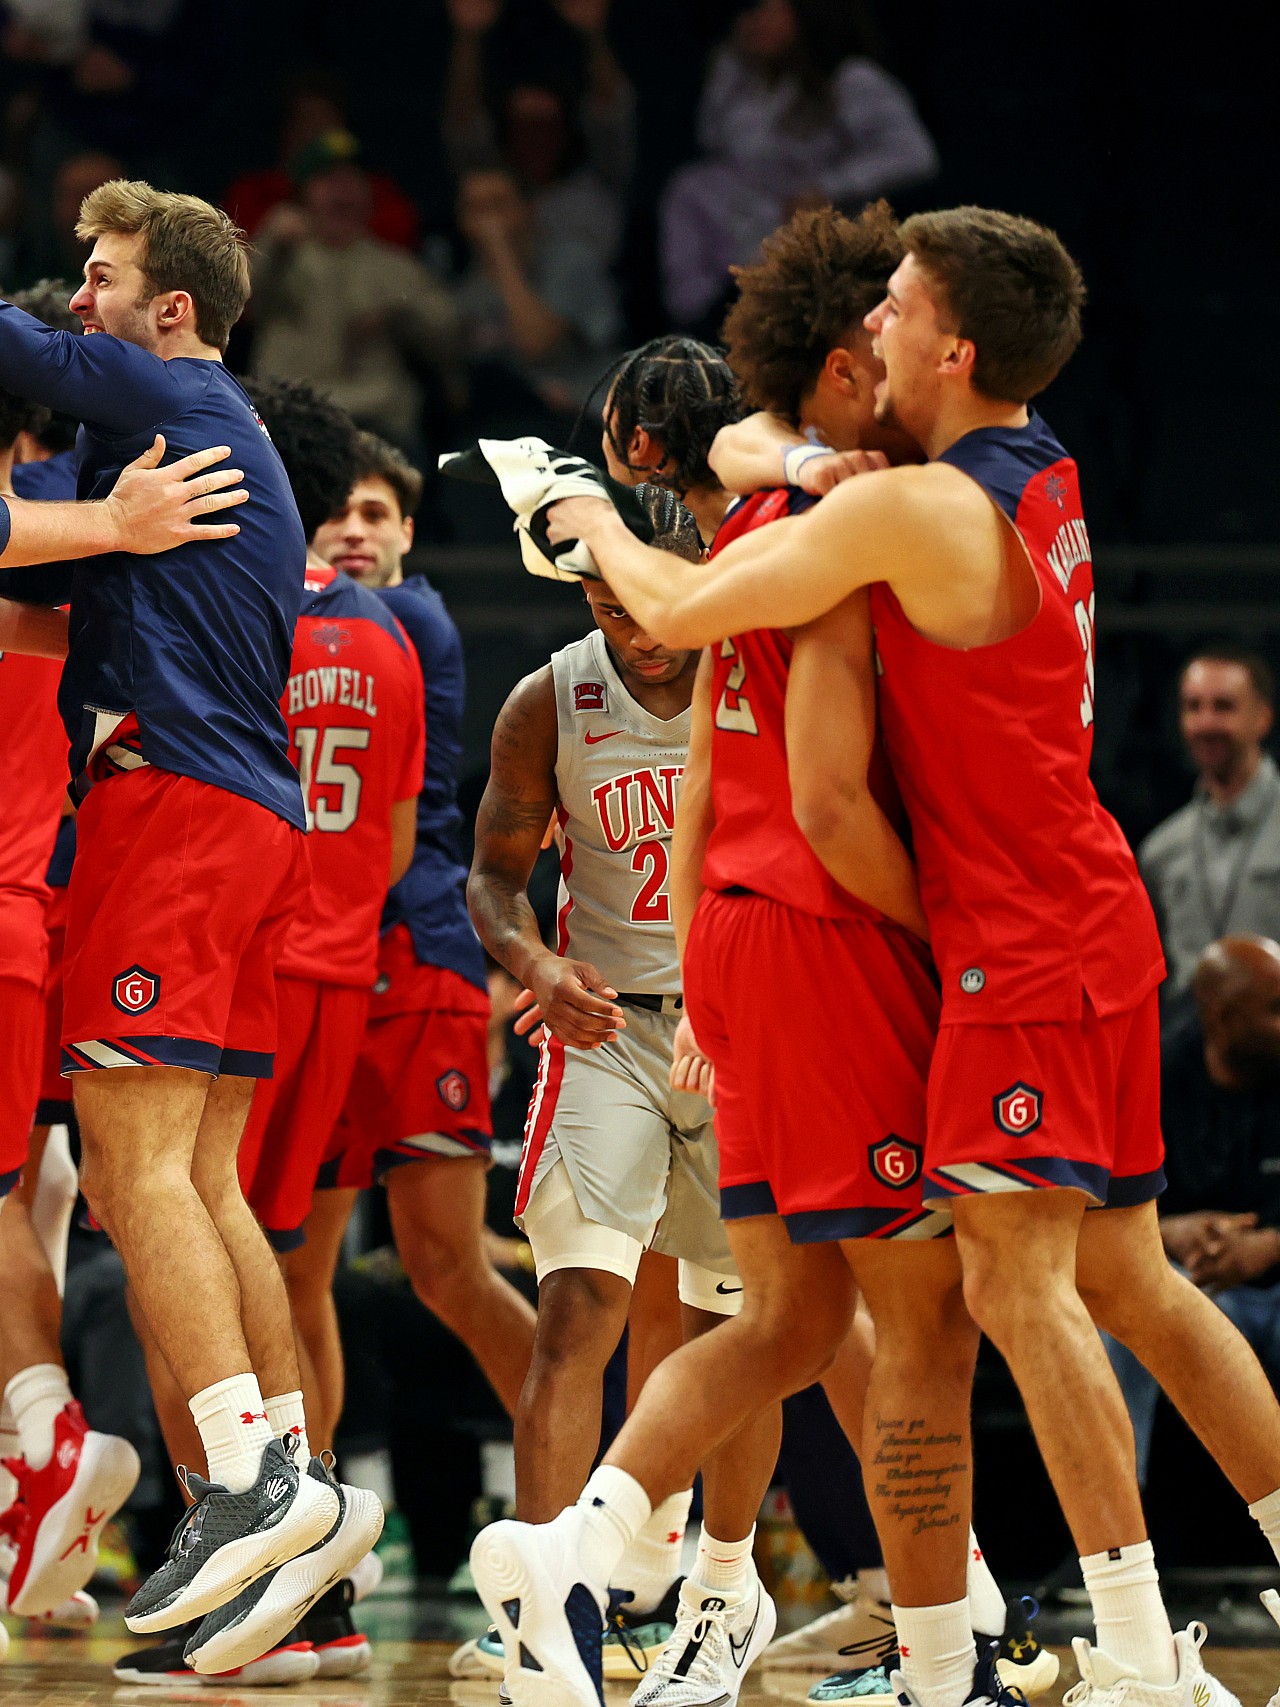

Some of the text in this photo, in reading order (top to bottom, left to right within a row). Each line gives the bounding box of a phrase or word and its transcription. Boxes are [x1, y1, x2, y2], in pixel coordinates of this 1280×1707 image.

[287, 666, 377, 718] HOWELL
[294, 727, 371, 833] 15
[590, 764, 686, 853] UN
[125, 980, 143, 1005] G
[1008, 1096, 1028, 1126] G
[884, 1150, 905, 1179] G
